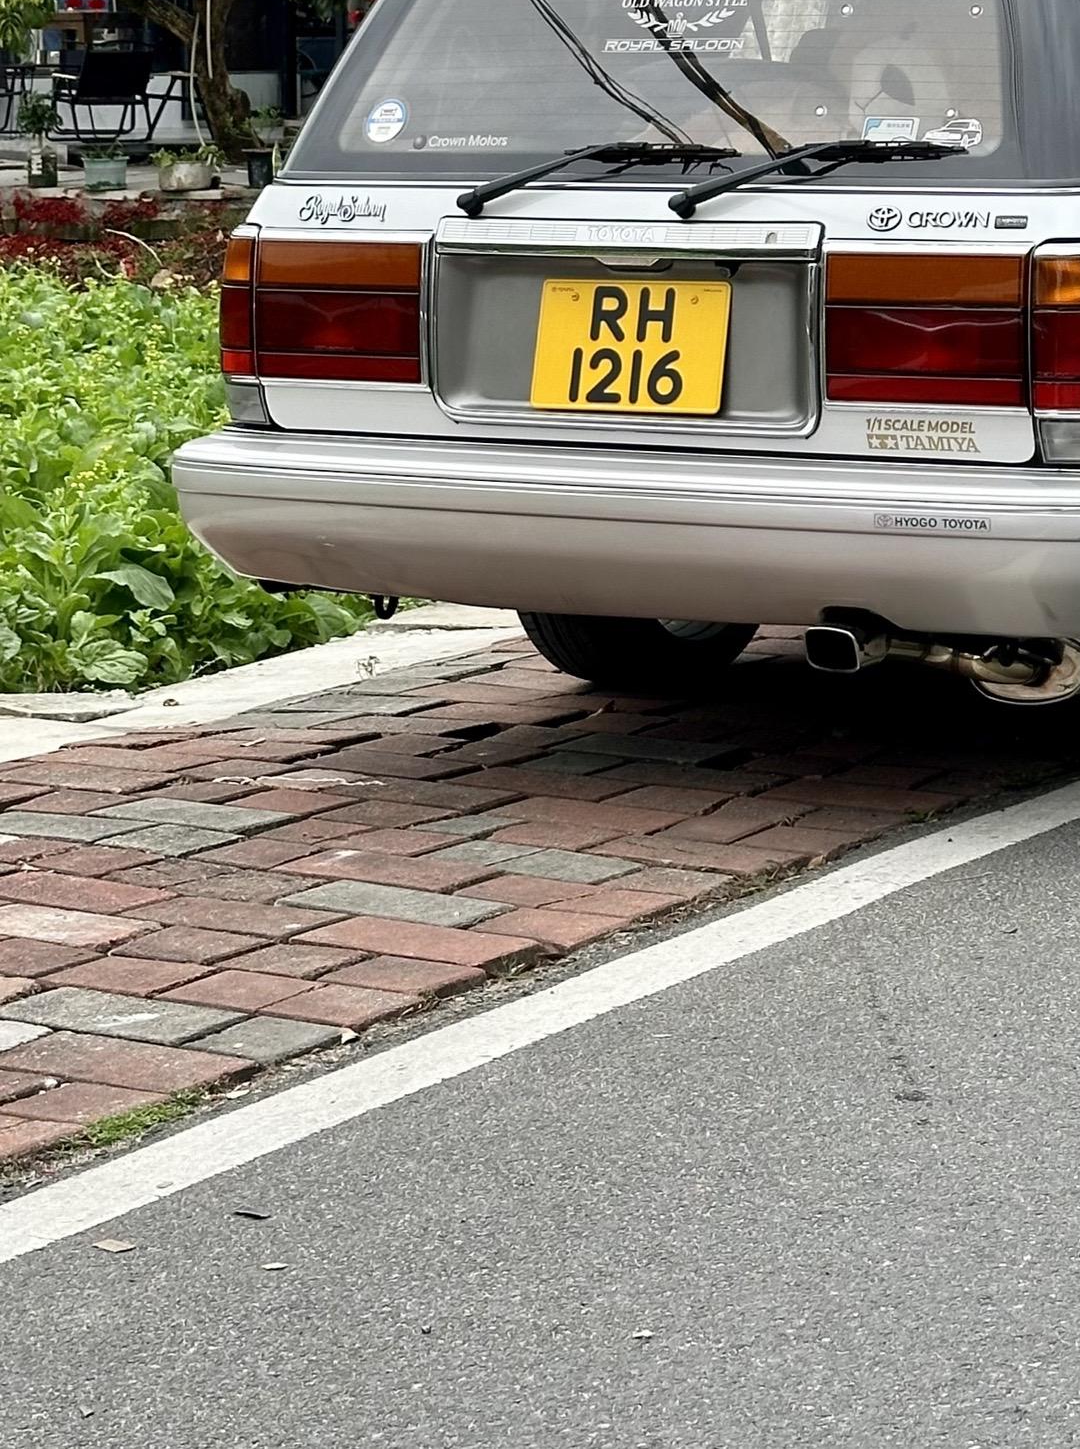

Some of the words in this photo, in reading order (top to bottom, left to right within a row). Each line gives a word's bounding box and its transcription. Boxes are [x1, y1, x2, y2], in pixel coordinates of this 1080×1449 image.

[604, 39, 665, 51] ROYAL
[668, 39, 745, 51] SALOON
[428, 135, 466, 147] Crown
[468, 134, 509, 147] Motors
[298, 194, 344, 225] Royal
[339, 195, 387, 223] Saloon
[908, 211, 991, 229] CROWN
[588, 225, 655, 243] TOYOTA
[589, 285, 676, 343] RH
[568, 347, 683, 405] 1216
[866, 417, 883, 432] 1/1
[884, 418, 925, 432] SCALE
[927, 420, 976, 434] MODEL
[900, 435, 981, 453] TAMIYA
[895, 516, 938, 528] HYOGO
[941, 518, 988, 530] TOYOTA
